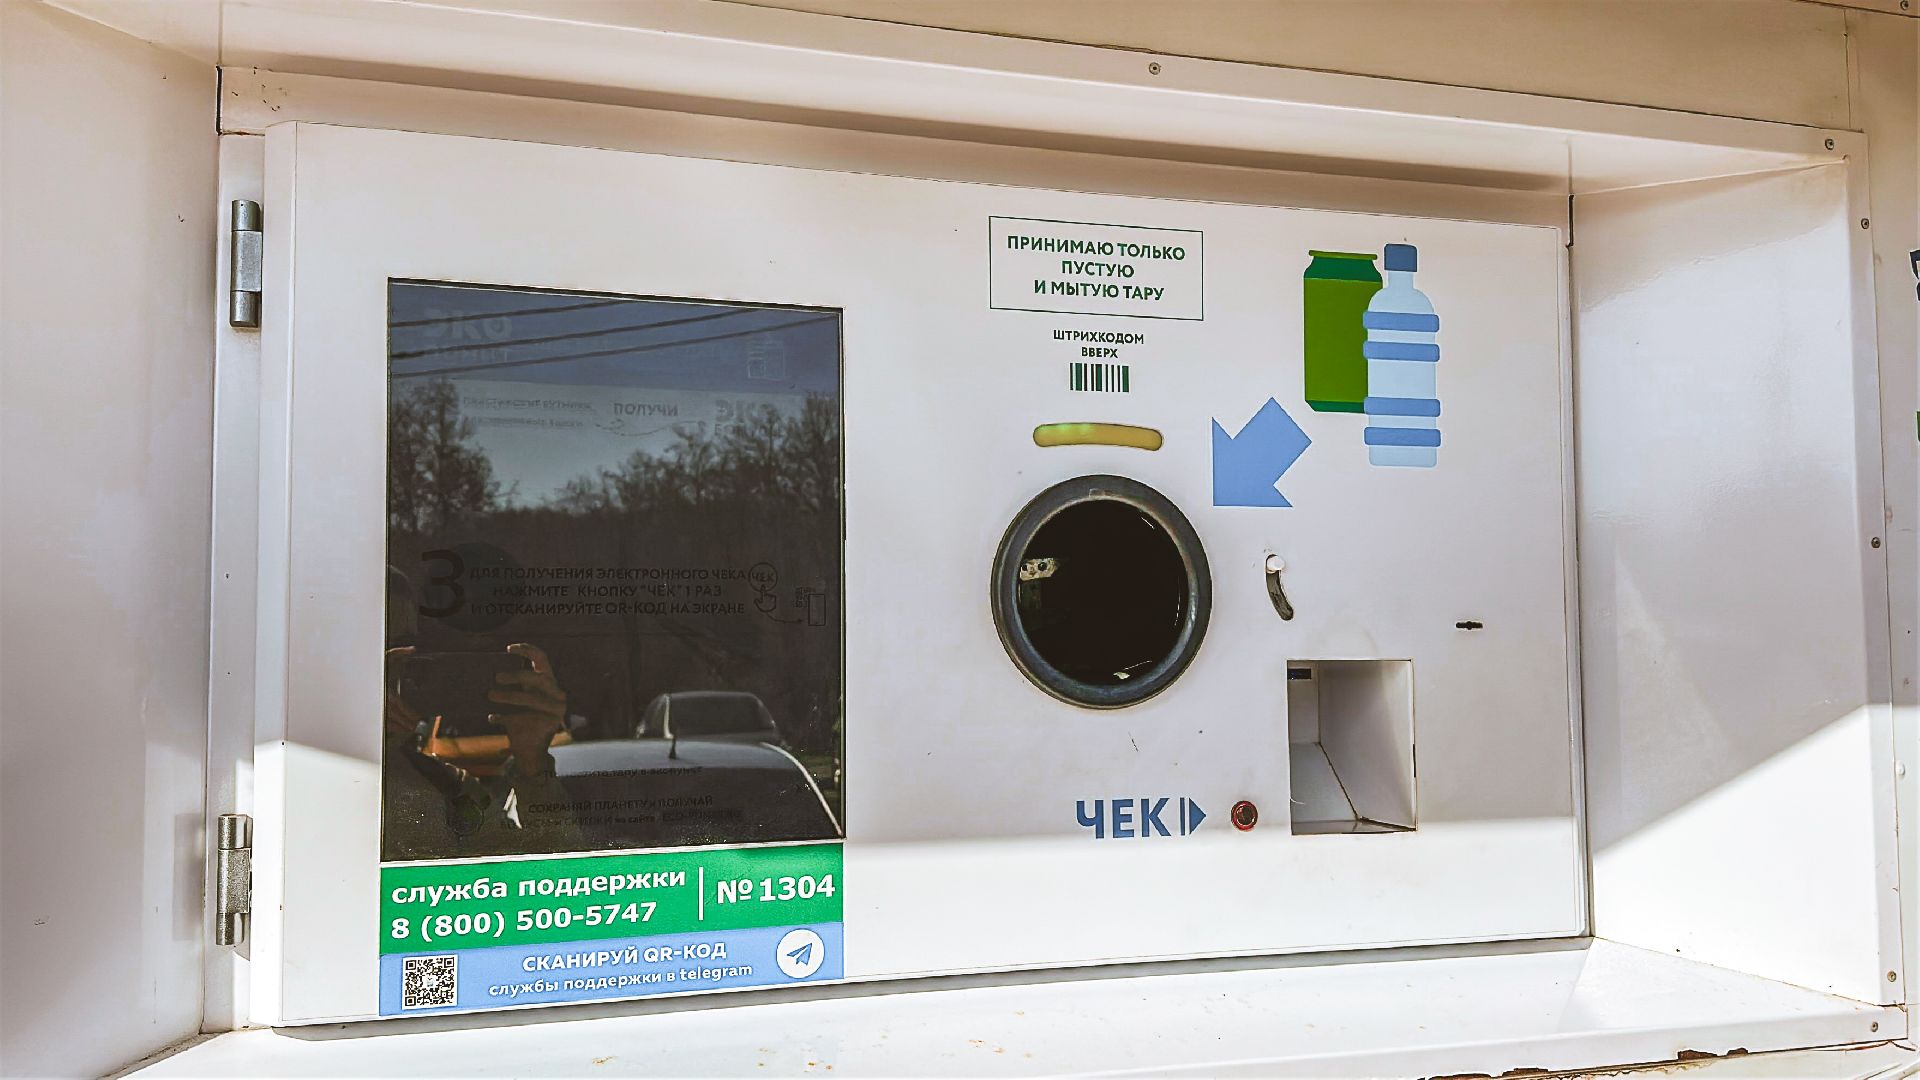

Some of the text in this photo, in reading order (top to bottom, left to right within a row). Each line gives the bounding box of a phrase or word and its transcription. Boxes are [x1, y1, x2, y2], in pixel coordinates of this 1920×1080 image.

[1007, 235, 1186, 260] ПРИНИМАЮ ТОЛЬКО
[1061, 260, 1135, 278] ПУСТУЮ
[1034, 279, 1165, 301] И МЫТУЮ ТАРУ
[1053, 329, 1144, 345] ШТРИХКОДОМ
[1081, 347, 1118, 359] ВВЕРХ
[613, 401, 679, 416] ПОЛУЧИ
[419, 549, 465, 617] 3
[470, 566, 747, 581] ДЛЯ ПОЛУЧЕНИЯ ЭЛЕКТРОННОГО ЧЕКА
[751, 571, 775, 583] ЧЕК
[493, 585, 569, 597] НАЖМИТЕ
[577, 585, 638, 598] КНОПКУ
[694, 585, 722, 597] РАЗ
[485, 601, 602, 616] ОТСКАНИРУЙТЕ
[605, 601, 668, 616] QR-КОД
[670, 602, 689, 615] НА
[691, 602, 745, 615] ЭКРАНЕ
[595, 799, 649, 811] ПЛАНЕТУ
[1076, 797, 1172, 839] ЧЕК
[391, 869, 687, 905] служба поддержки
[759, 874, 835, 902] 1304
[391, 901, 657, 943] 8 (800) 500-5747
[522, 942, 727, 973] СКАНИРУЙ QR-КОД
[488, 963, 753, 997] службы поддержки в telegram
